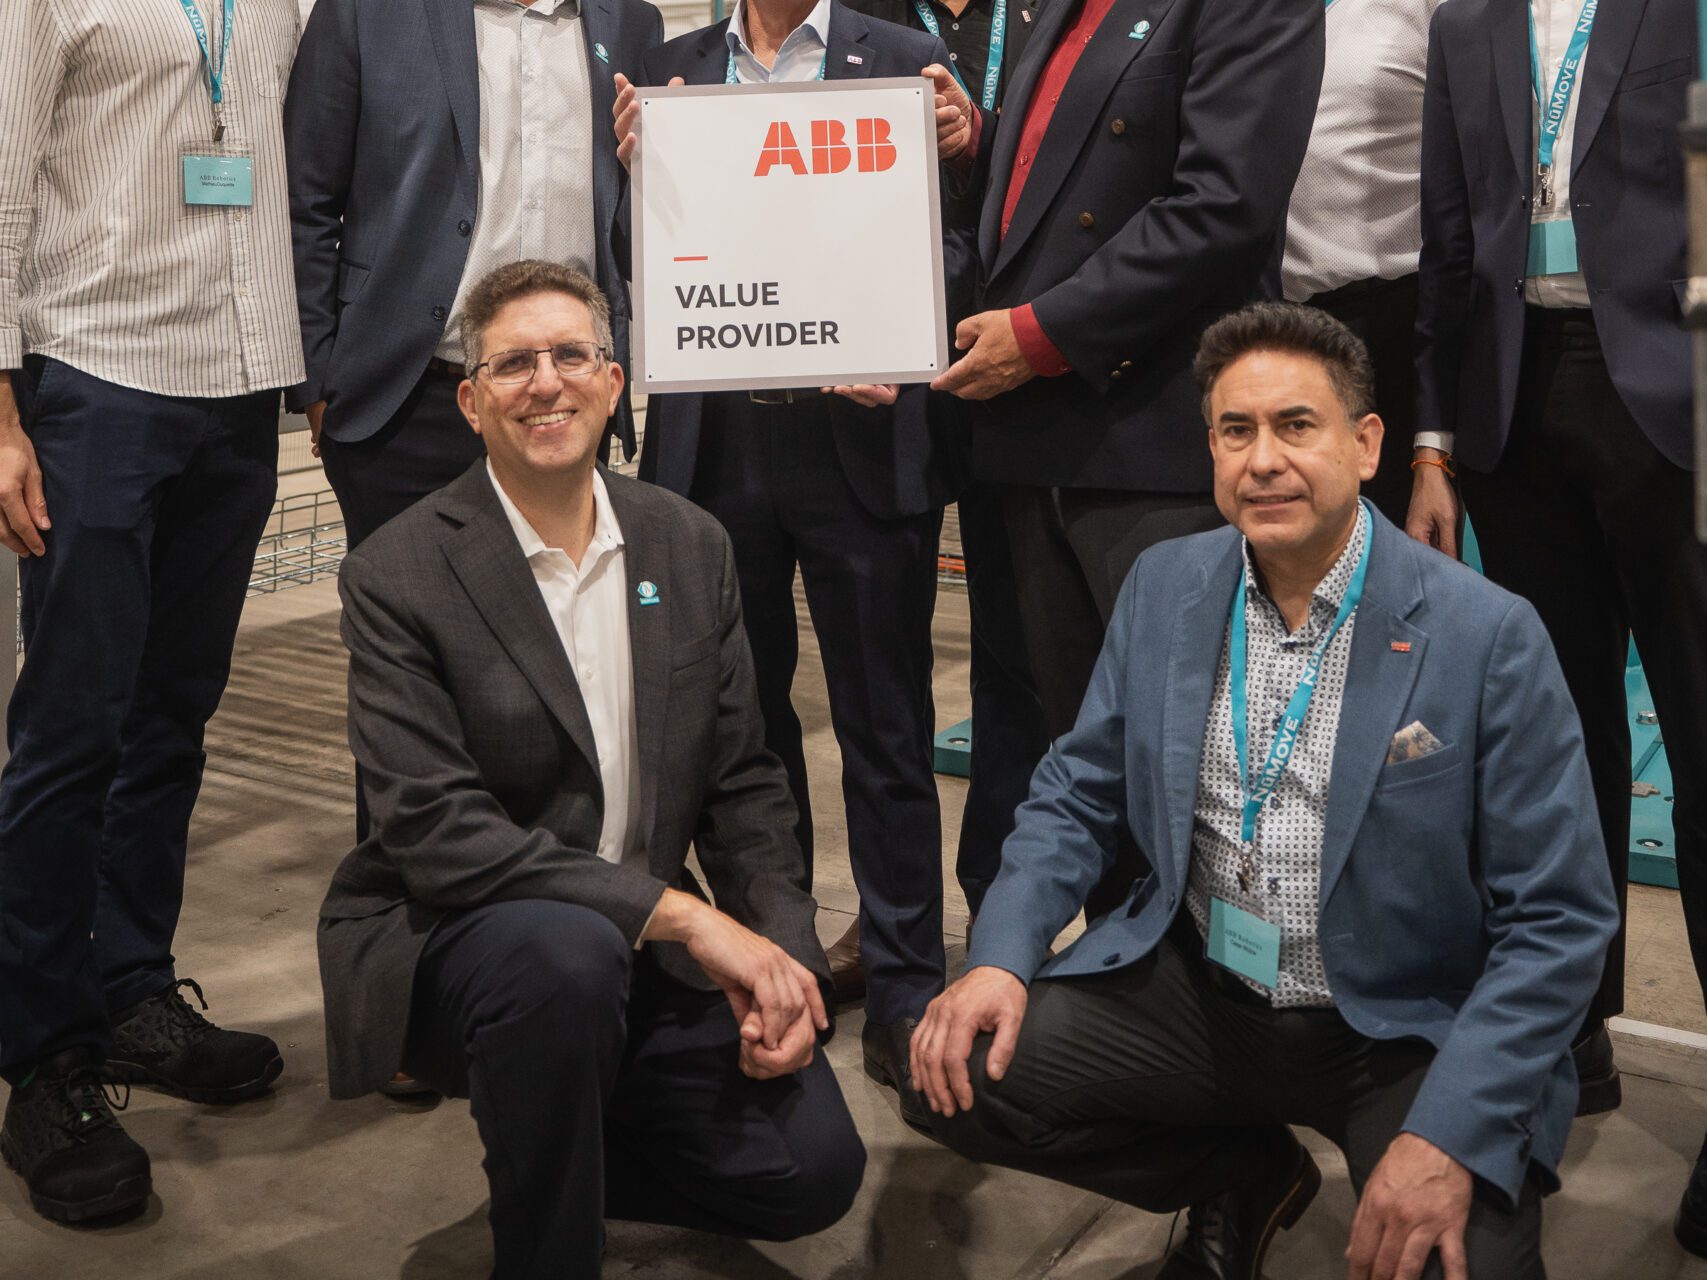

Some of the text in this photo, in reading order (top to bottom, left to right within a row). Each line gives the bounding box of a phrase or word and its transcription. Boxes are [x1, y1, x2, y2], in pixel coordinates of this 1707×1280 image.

[753, 117, 897, 177] ABB
[674, 282, 780, 309] VALUE
[677, 320, 840, 350] PROVIDER
